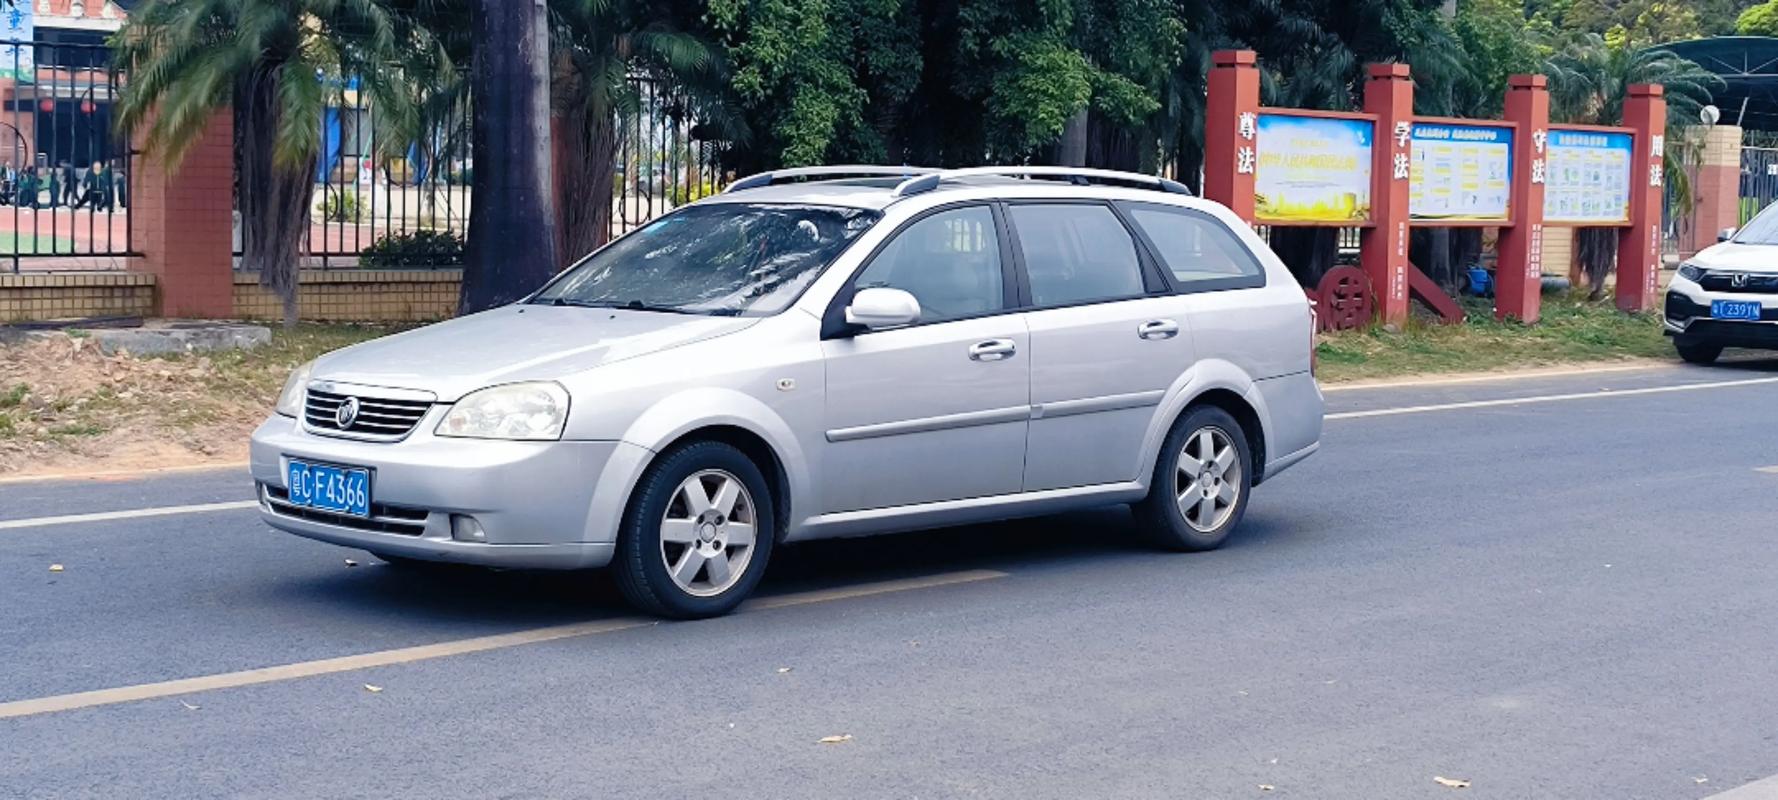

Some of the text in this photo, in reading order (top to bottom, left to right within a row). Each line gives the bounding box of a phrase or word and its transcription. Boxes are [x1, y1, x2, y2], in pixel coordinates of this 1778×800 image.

[1238, 112, 1256, 174] 尊法
[1394, 121, 1410, 179] 学法
[1532, 128, 1546, 183] 守法
[1650, 135, 1664, 186] 用法
